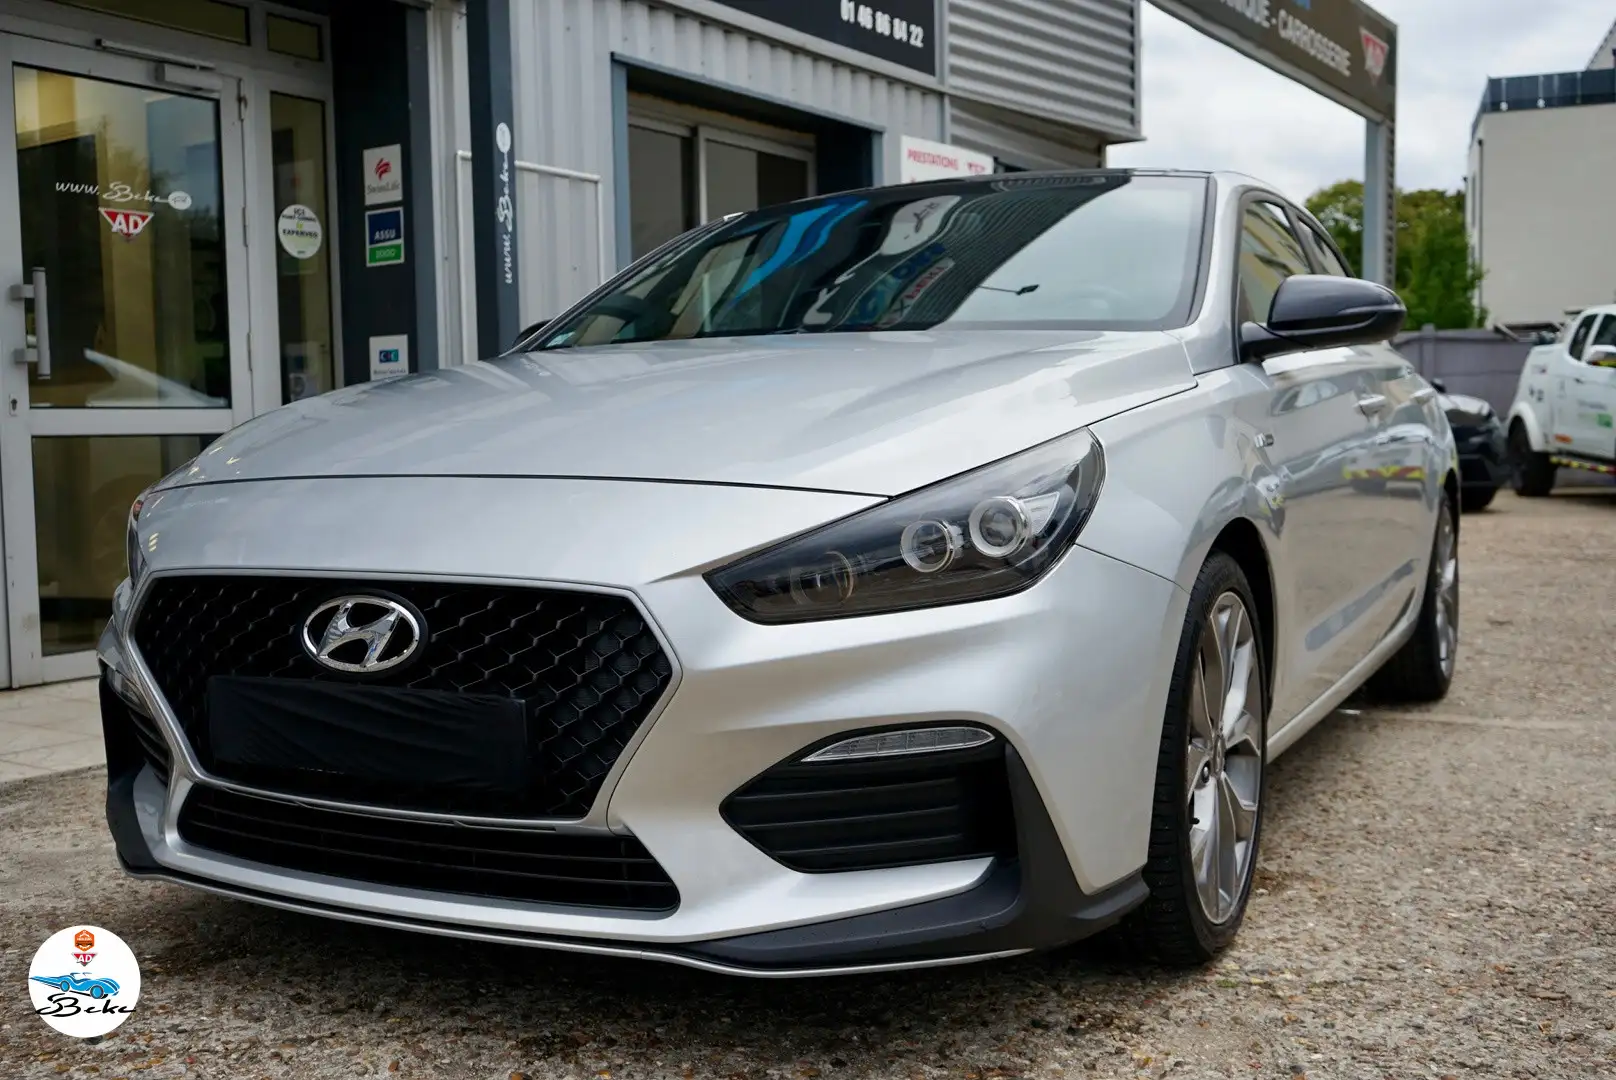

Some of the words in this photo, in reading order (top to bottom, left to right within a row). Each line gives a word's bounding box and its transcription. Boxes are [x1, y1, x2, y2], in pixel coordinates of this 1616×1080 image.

[909, 24, 924, 48] 22
[1278, 9, 1351, 77] CARROSSERIE
[907, 147, 958, 170] PRESTATIONS
[111, 213, 143, 234] AD
[374, 228, 396, 241] ASSU
